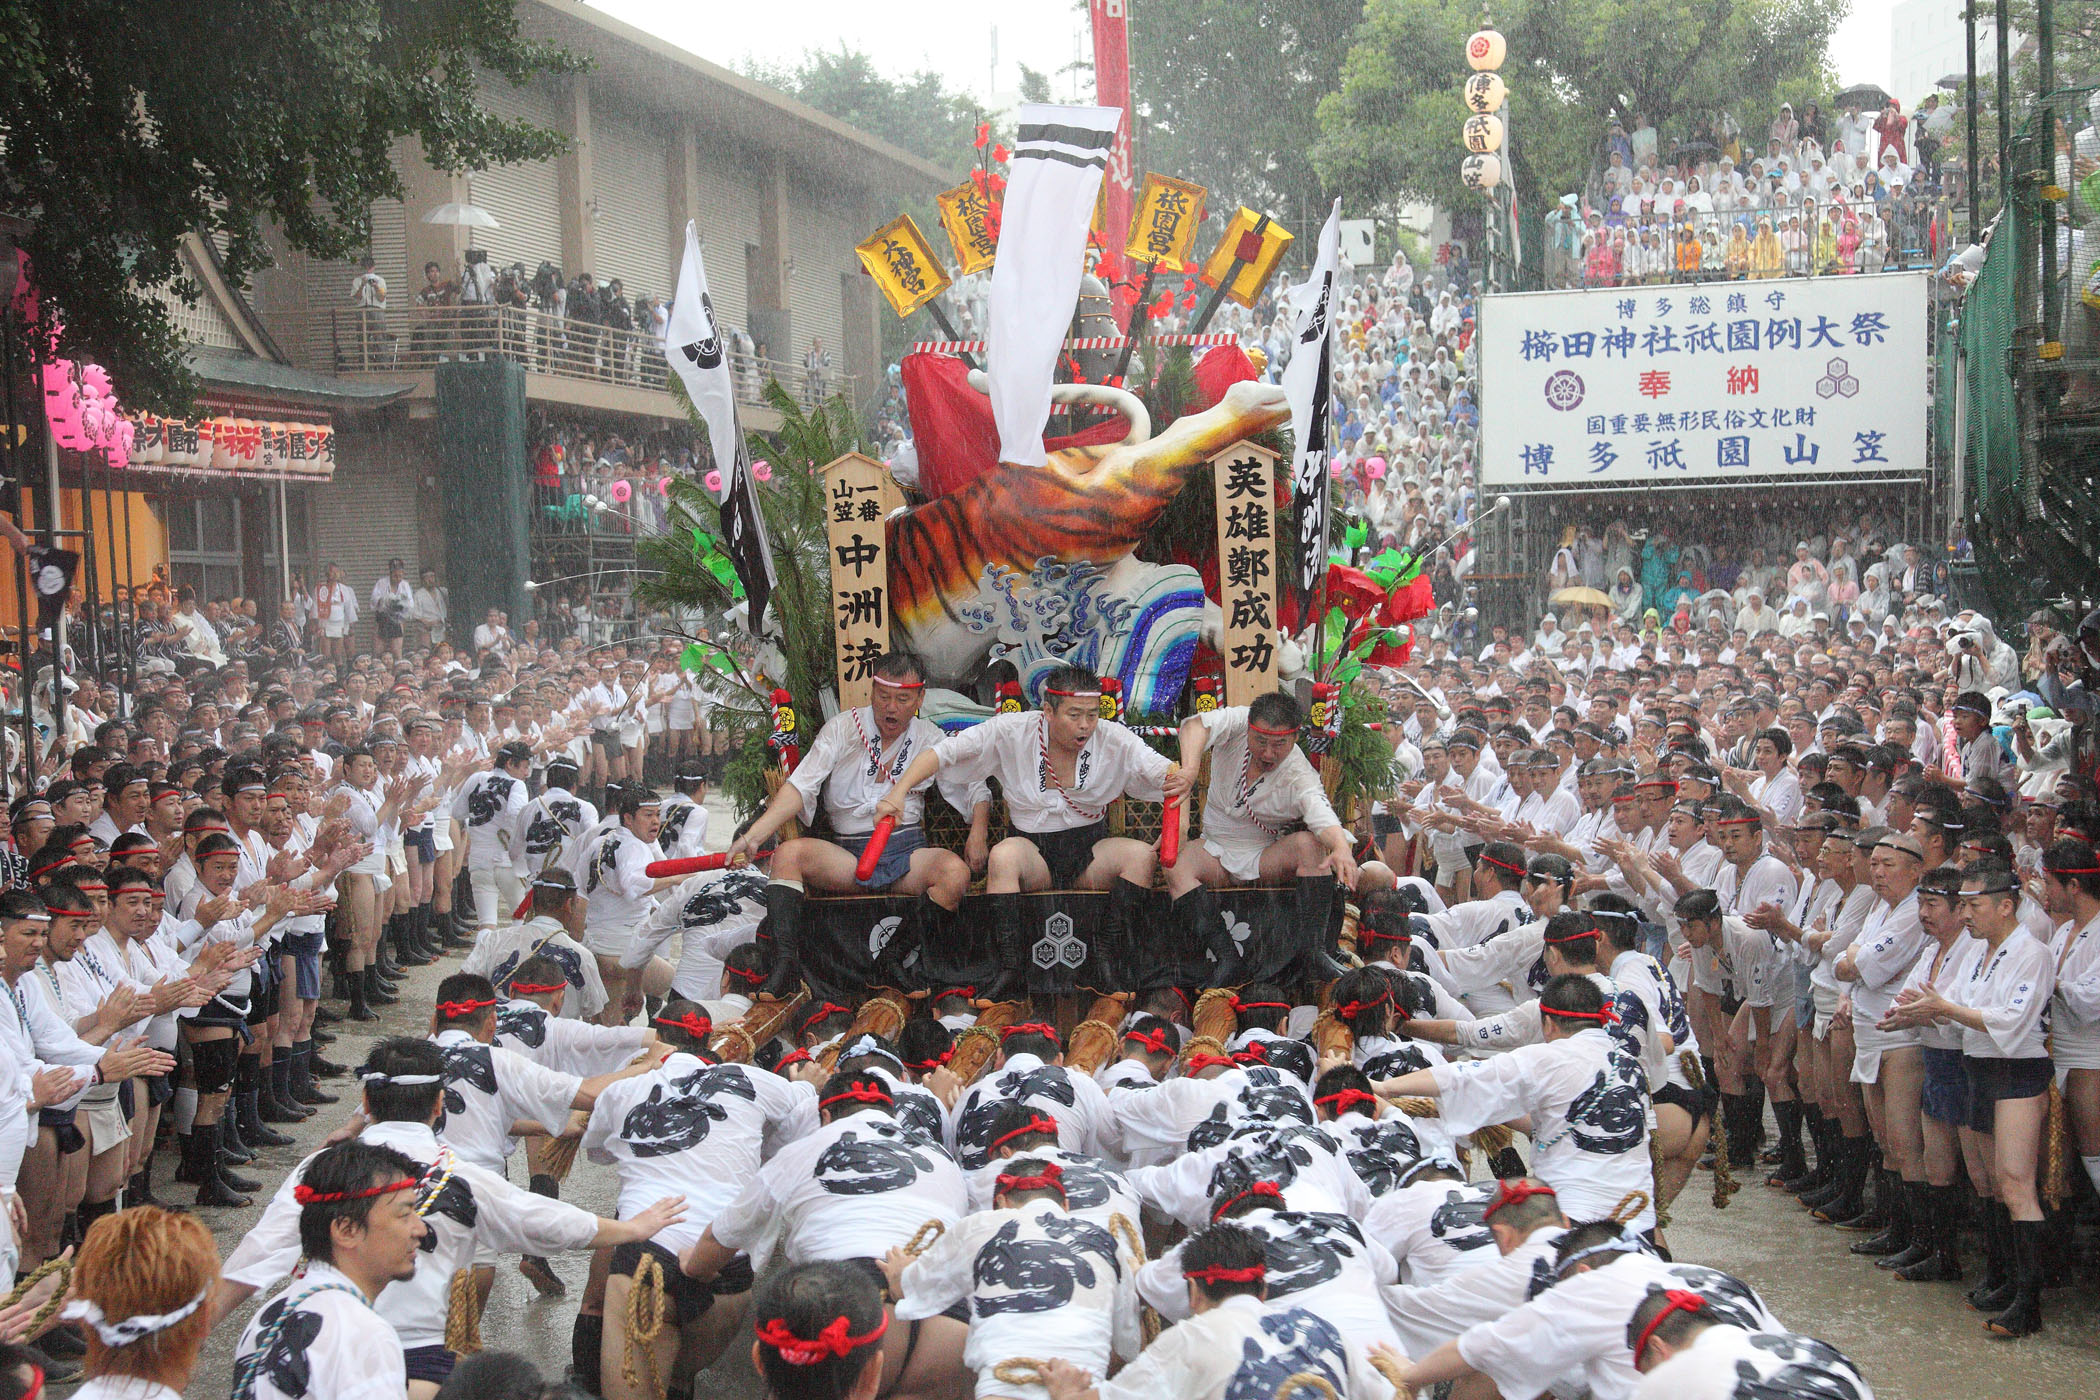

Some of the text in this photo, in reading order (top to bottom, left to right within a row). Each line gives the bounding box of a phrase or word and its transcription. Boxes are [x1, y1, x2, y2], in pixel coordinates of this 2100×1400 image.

[1147, 187, 1189, 256] 祇園宮
[1616, 290, 1787, 318] 博多総鎮守
[1518, 312, 1891, 362] 櫛田神社祇園例大祭
[1638, 364, 1760, 400] 奉納
[1586, 406, 1818, 436] 国重要無形民俗文化財
[1518, 430, 1890, 475] 博多祇園山笠
[1224, 456, 1275, 674] 英雄鄭成功
[835, 533, 884, 683] 中洲流
